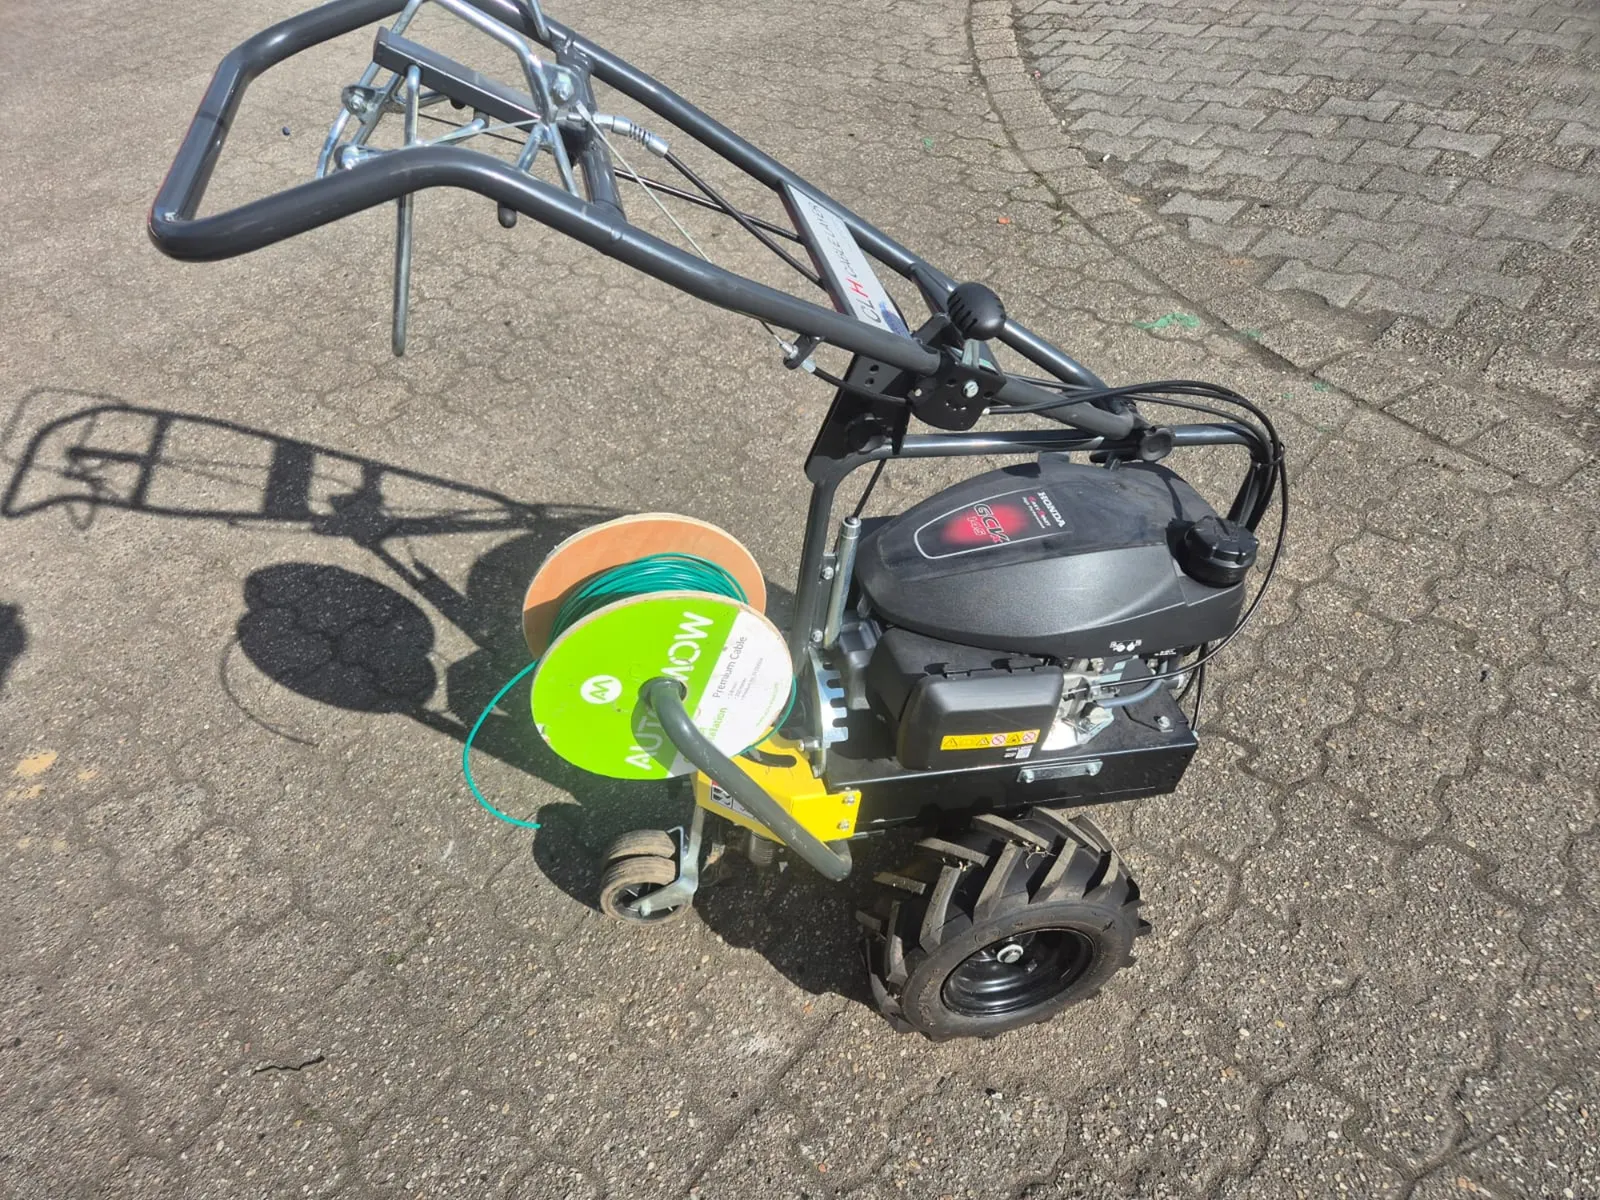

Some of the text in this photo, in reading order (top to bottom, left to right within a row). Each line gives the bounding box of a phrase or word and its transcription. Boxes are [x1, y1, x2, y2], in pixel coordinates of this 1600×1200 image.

[1037, 491, 1067, 528] HONDA
[712, 660, 736, 698] Premium
[729, 636, 748, 661] Cable
